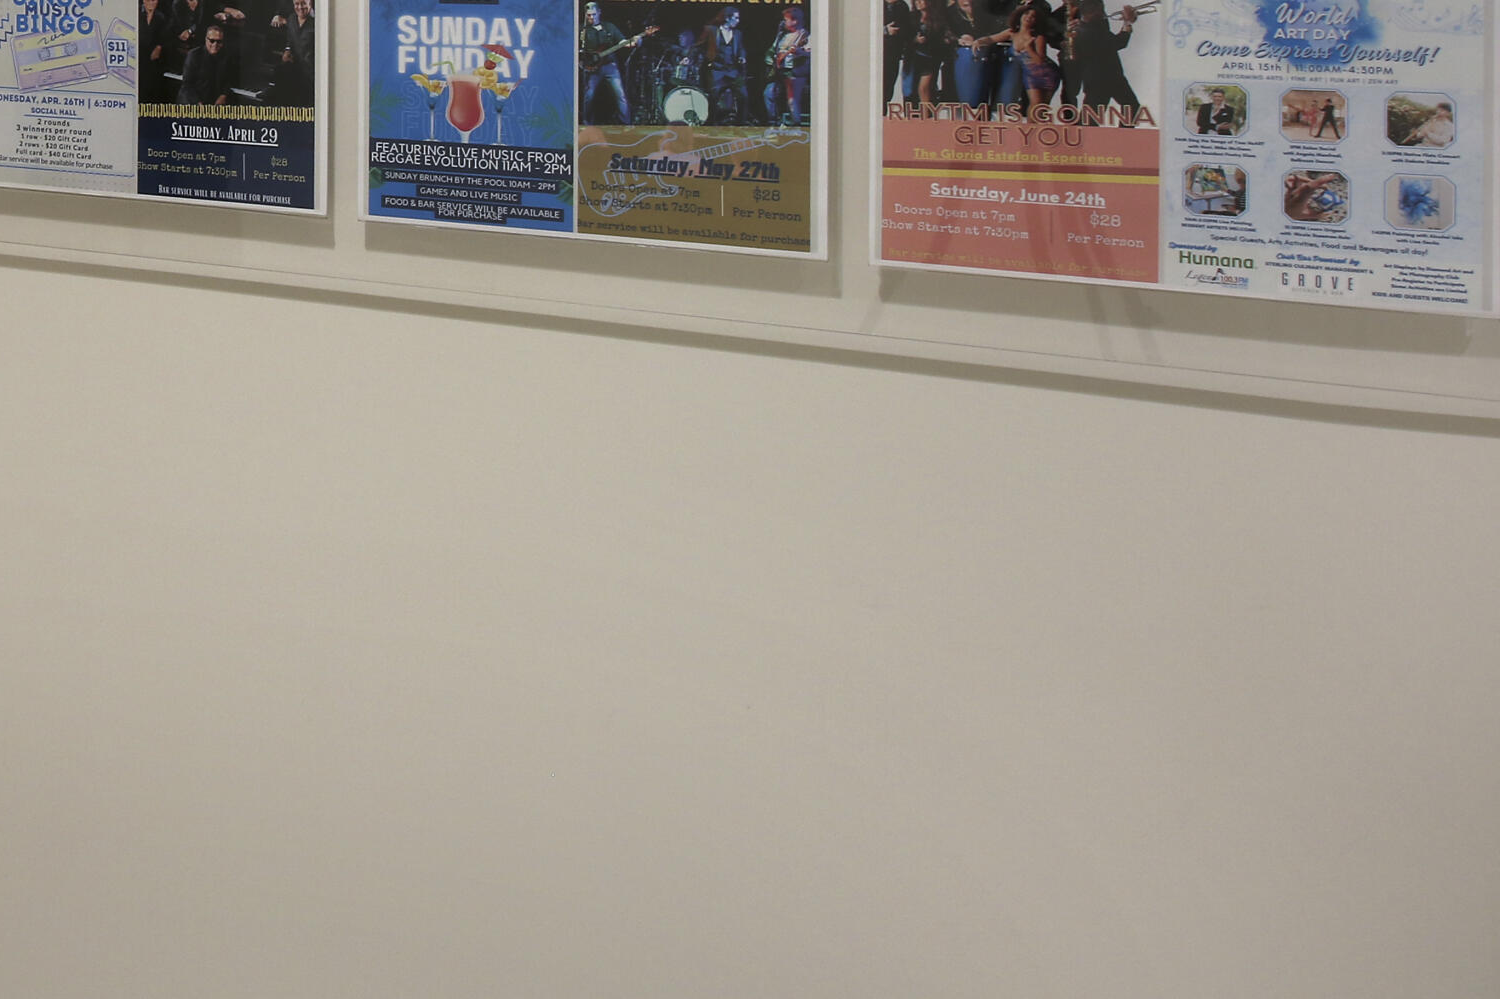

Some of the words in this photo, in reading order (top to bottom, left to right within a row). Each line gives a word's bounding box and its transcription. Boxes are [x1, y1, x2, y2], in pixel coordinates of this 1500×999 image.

[25, 3, 84, 17] MUSIC
[1276, 2, 1352, 24] World
[16, 14, 94, 35] BINGO
[397, 15, 535, 47] SUNDAY
[1274, 28, 1309, 39] ART
[1313, 29, 1351, 40] DAY
[110, 55, 125, 64] PP
[398, 46, 534, 79] FUNDAY
[1196, 40, 1249, 58] Come
[1254, 43, 1332, 61] Express
[1339, 45, 1440, 67] Yourself!
[41, 95, 60, 104] APR.
[64, 98, 85, 106] 26TH
[94, 100, 126, 109] 6:30PM
[888, 102, 987, 122] RHYTM
[997, 103, 1022, 123] IS
[1031, 103, 1156, 127] GONNA
[260, 128, 278, 143] 29
[954, 126, 1007, 146] GET
[1020, 127, 1083, 147] YOU
[914, 149, 938, 160] The
[941, 149, 984, 161] Gloria
[987, 150, 1039, 163] Estefan
[1043, 152, 1123, 165] Experience
[930, 183, 1014, 202] Saturday,
[1020, 189, 1059, 203] June
[1065, 192, 1106, 206] 24th
[1179, 251, 1254, 269] Humana
[1281, 272, 1354, 290] GROVE
